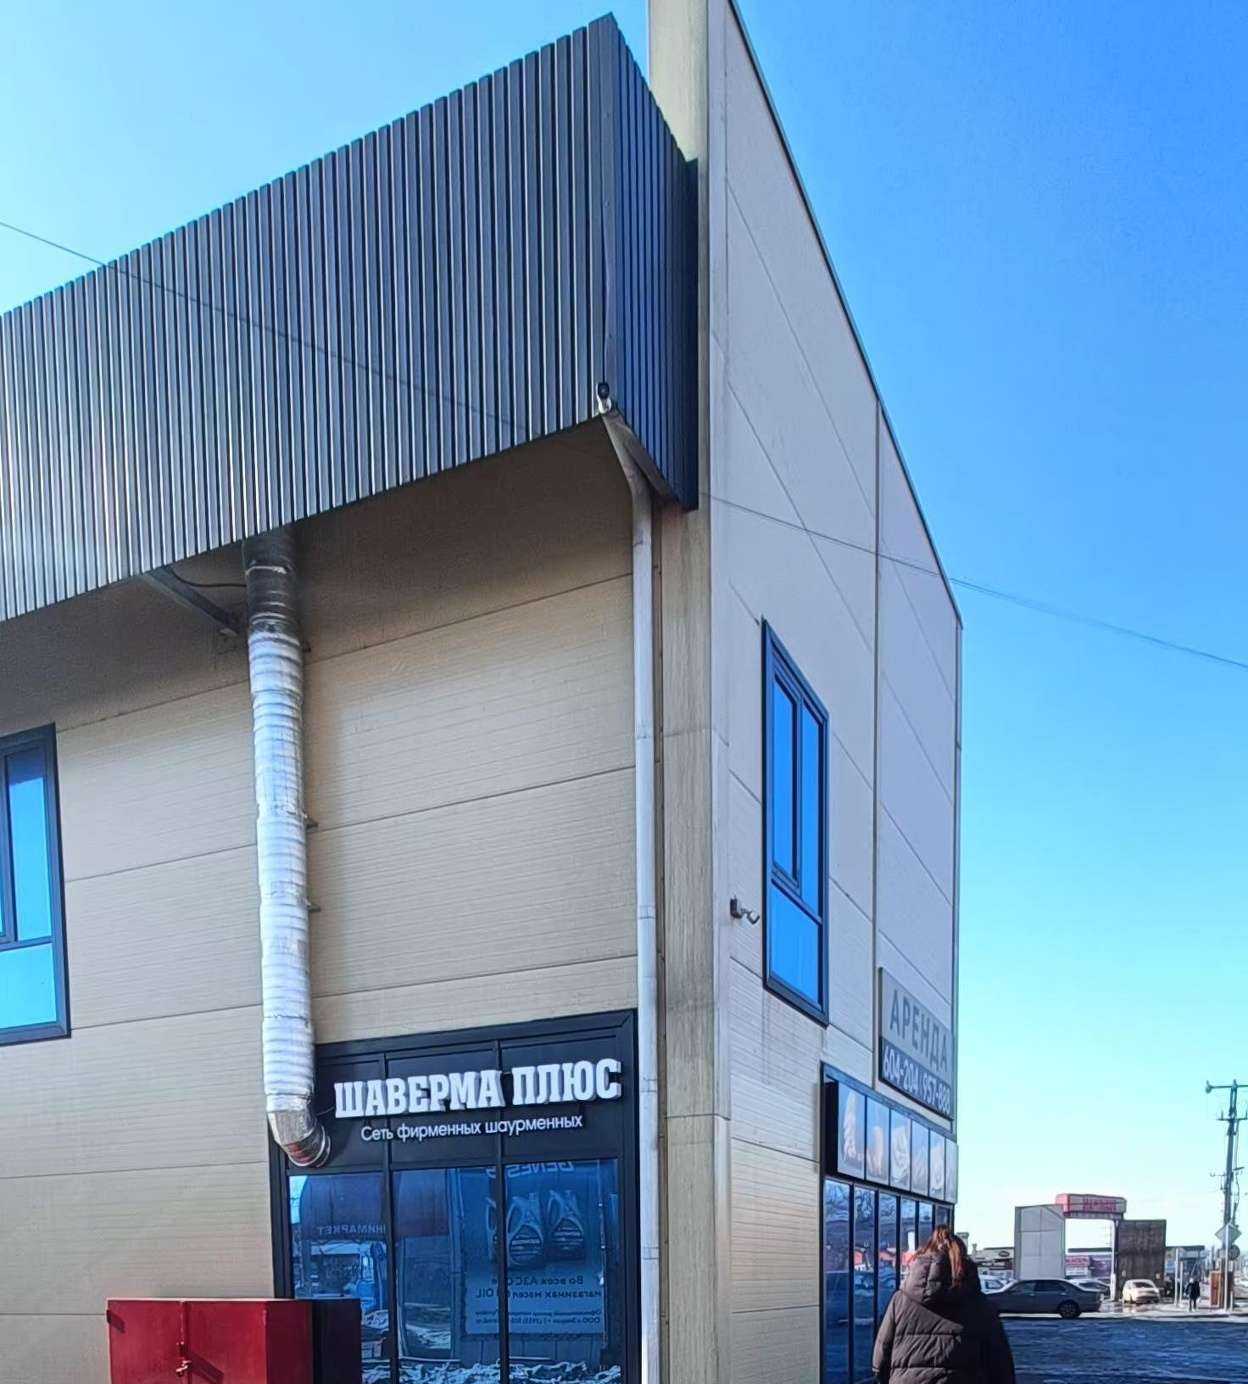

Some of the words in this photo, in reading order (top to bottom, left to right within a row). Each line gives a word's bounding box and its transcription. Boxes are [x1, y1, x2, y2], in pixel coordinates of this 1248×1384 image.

[889, 989, 948, 1073] АРЕНДА
[334, 1070, 506, 1118] ШАВЕРМА
[512, 1058, 621, 1105] ПЛЮС
[361, 1126, 394, 1141] Сеть
[397, 1120, 481, 1143] фирменных
[485, 1115, 583, 1137] шаурменных
